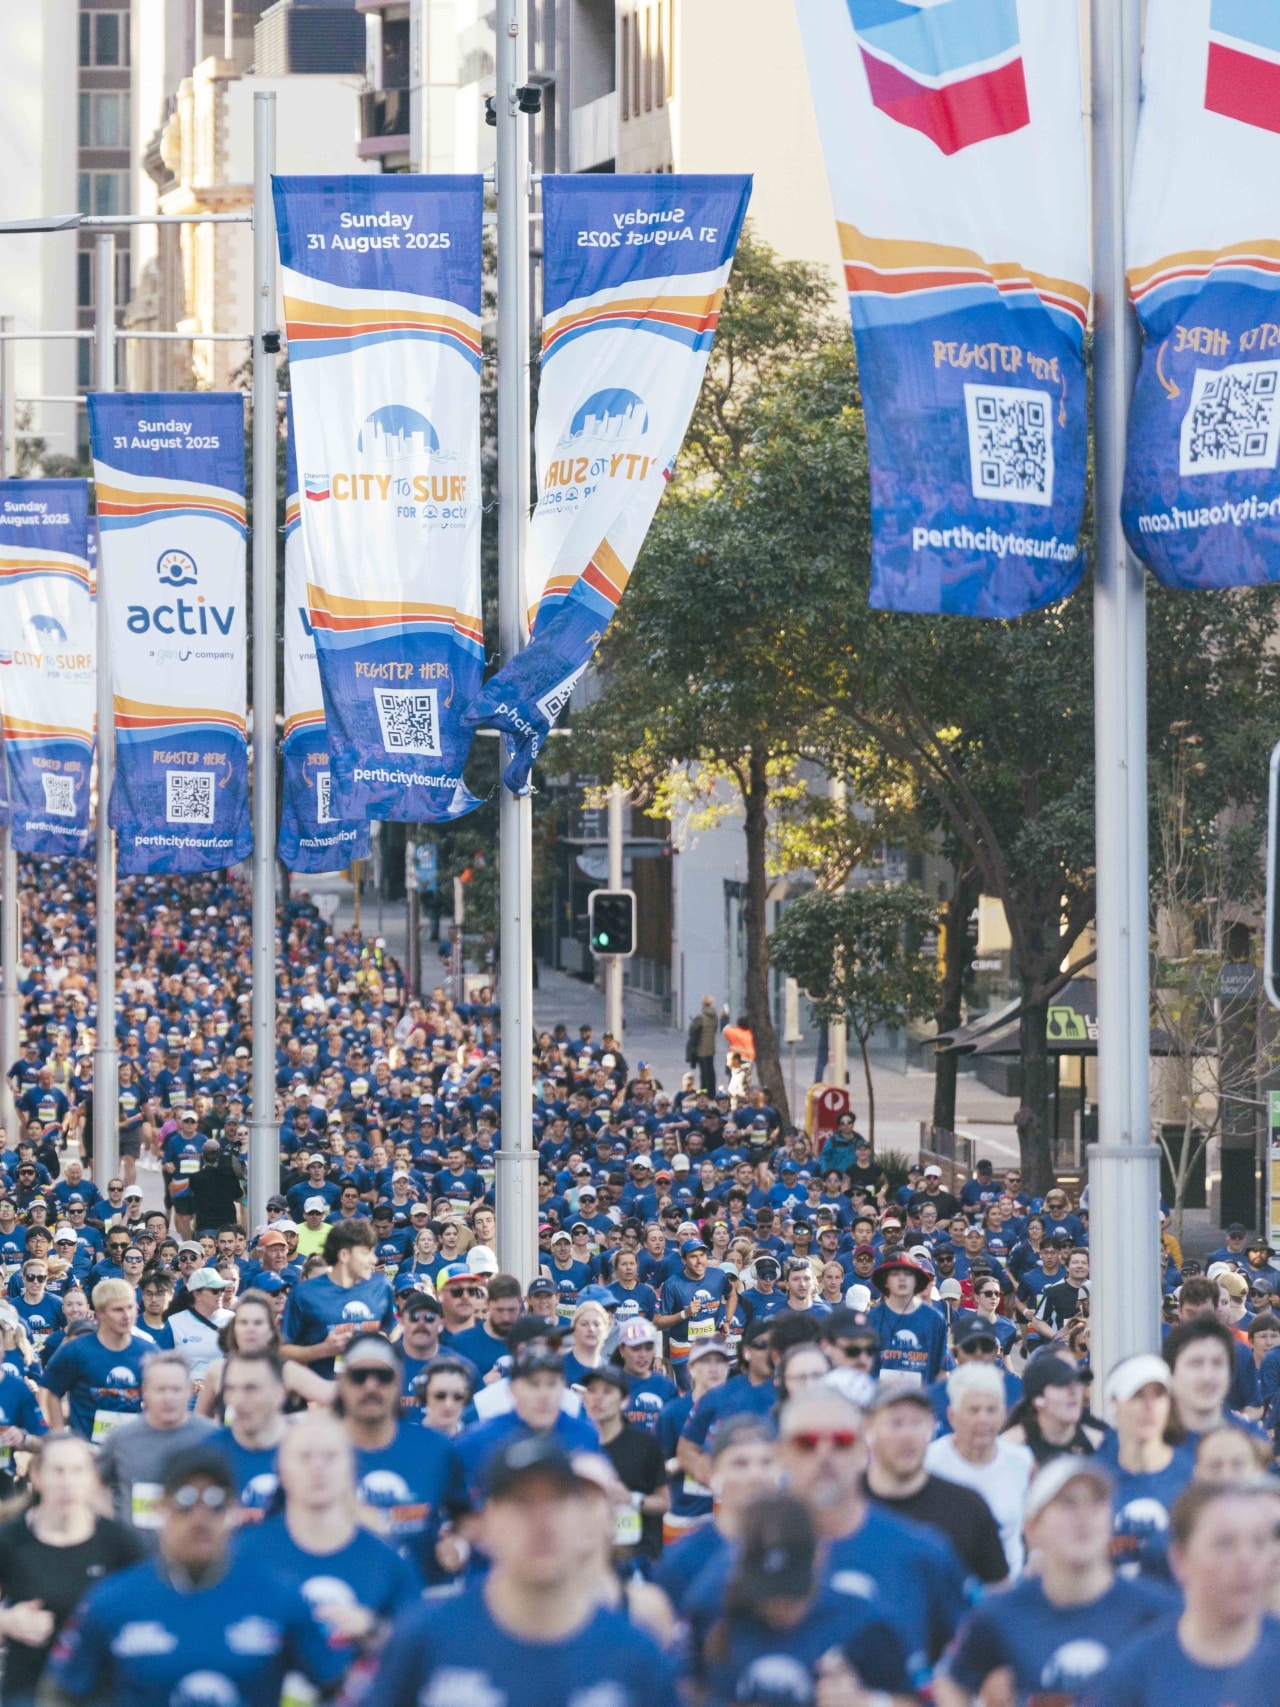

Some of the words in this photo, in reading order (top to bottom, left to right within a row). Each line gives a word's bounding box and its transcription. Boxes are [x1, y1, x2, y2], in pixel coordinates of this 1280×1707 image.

[340, 211, 414, 231] Sunday
[307, 233, 326, 250] 31
[331, 233, 400, 253] August
[405, 232, 451, 249] 2025
[933, 341, 1022, 374] REGISTER
[137, 419, 193, 435] Sunday
[113, 436, 128, 449] 31
[131, 436, 182, 451] August
[186, 436, 220, 449] 2025
[332, 473, 390, 501] CITY
[3, 500, 48, 514] Sunday
[397, 506, 416, 518] FOR
[42, 513, 70, 524] 2025
[126, 595, 236, 636] activ
[13, 651, 43, 669] CITY
[195, 650, 235, 660] company
[354, 661, 413, 681] REGISTER
[418, 663, 449, 680] HERE
[152, 750, 200, 767] REGISTER
[204, 752, 227, 767] HERE
[353, 767, 460, 790] perthcitytosurf.co
[690, 1326, 713, 1334] 17765
[883, 1349, 902, 1360] CITY
